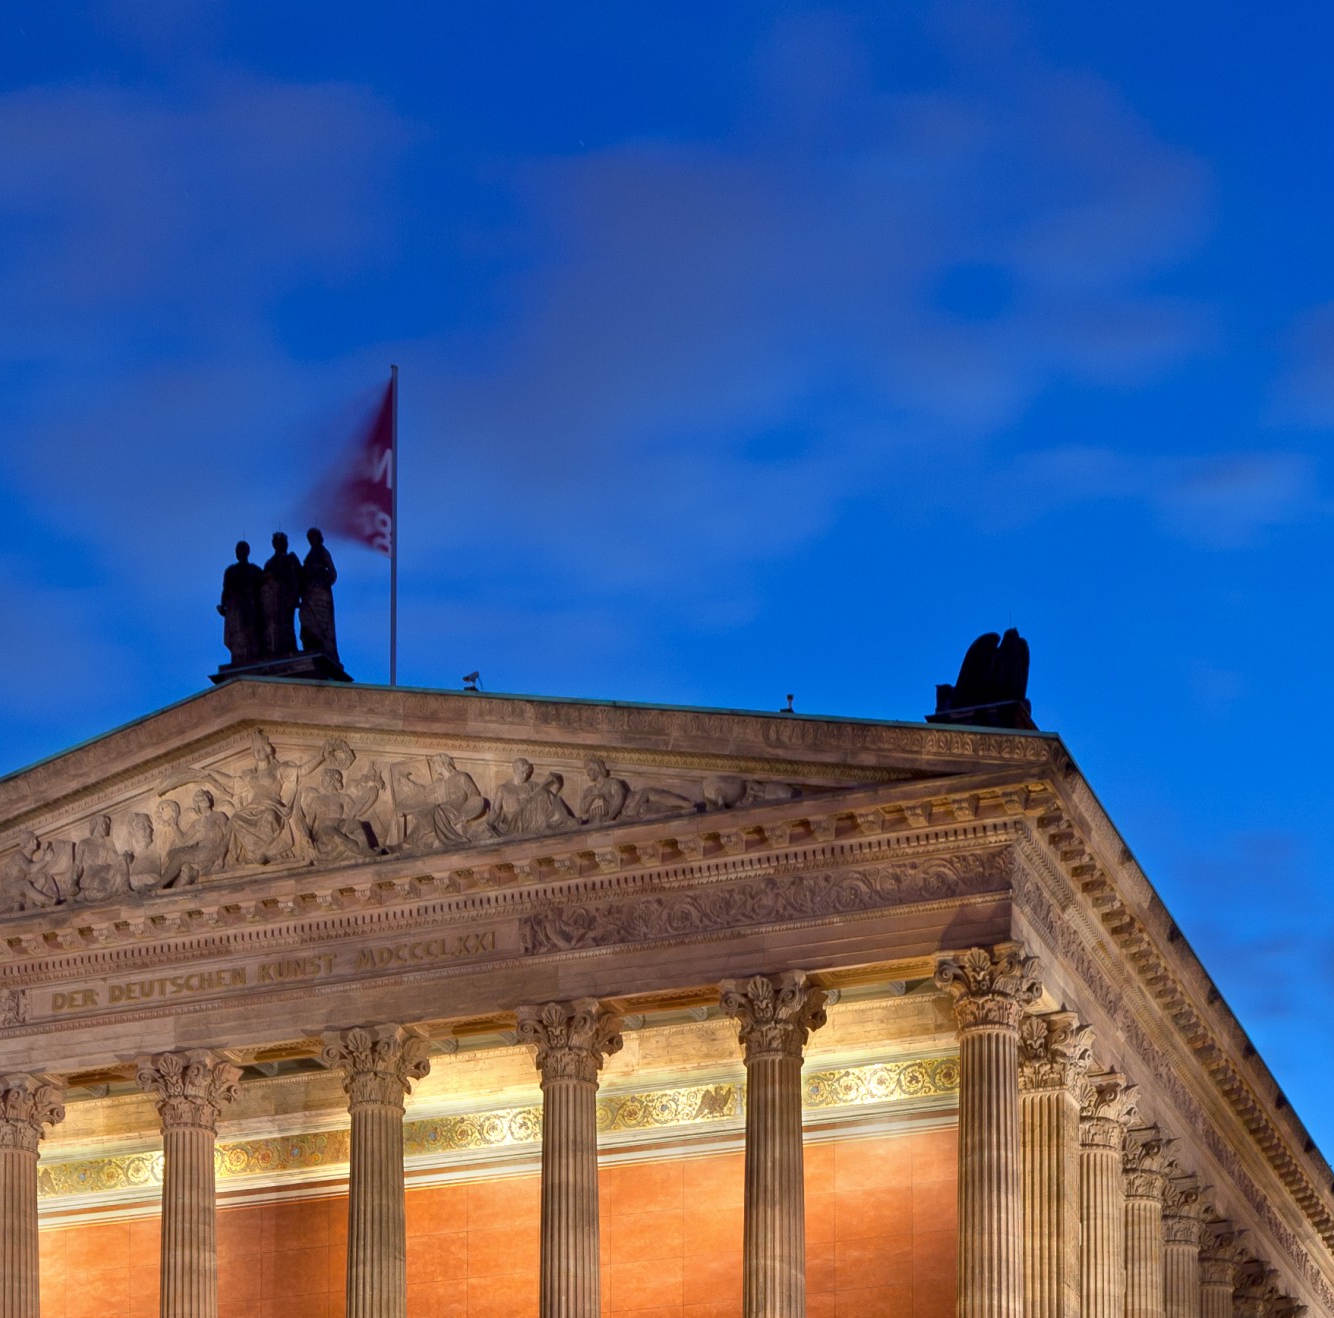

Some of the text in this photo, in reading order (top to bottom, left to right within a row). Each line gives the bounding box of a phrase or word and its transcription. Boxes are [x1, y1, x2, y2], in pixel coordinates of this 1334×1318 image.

[52, 931, 496, 1012] DER DEUTSCHEN KUNST MDCCCLXXI
